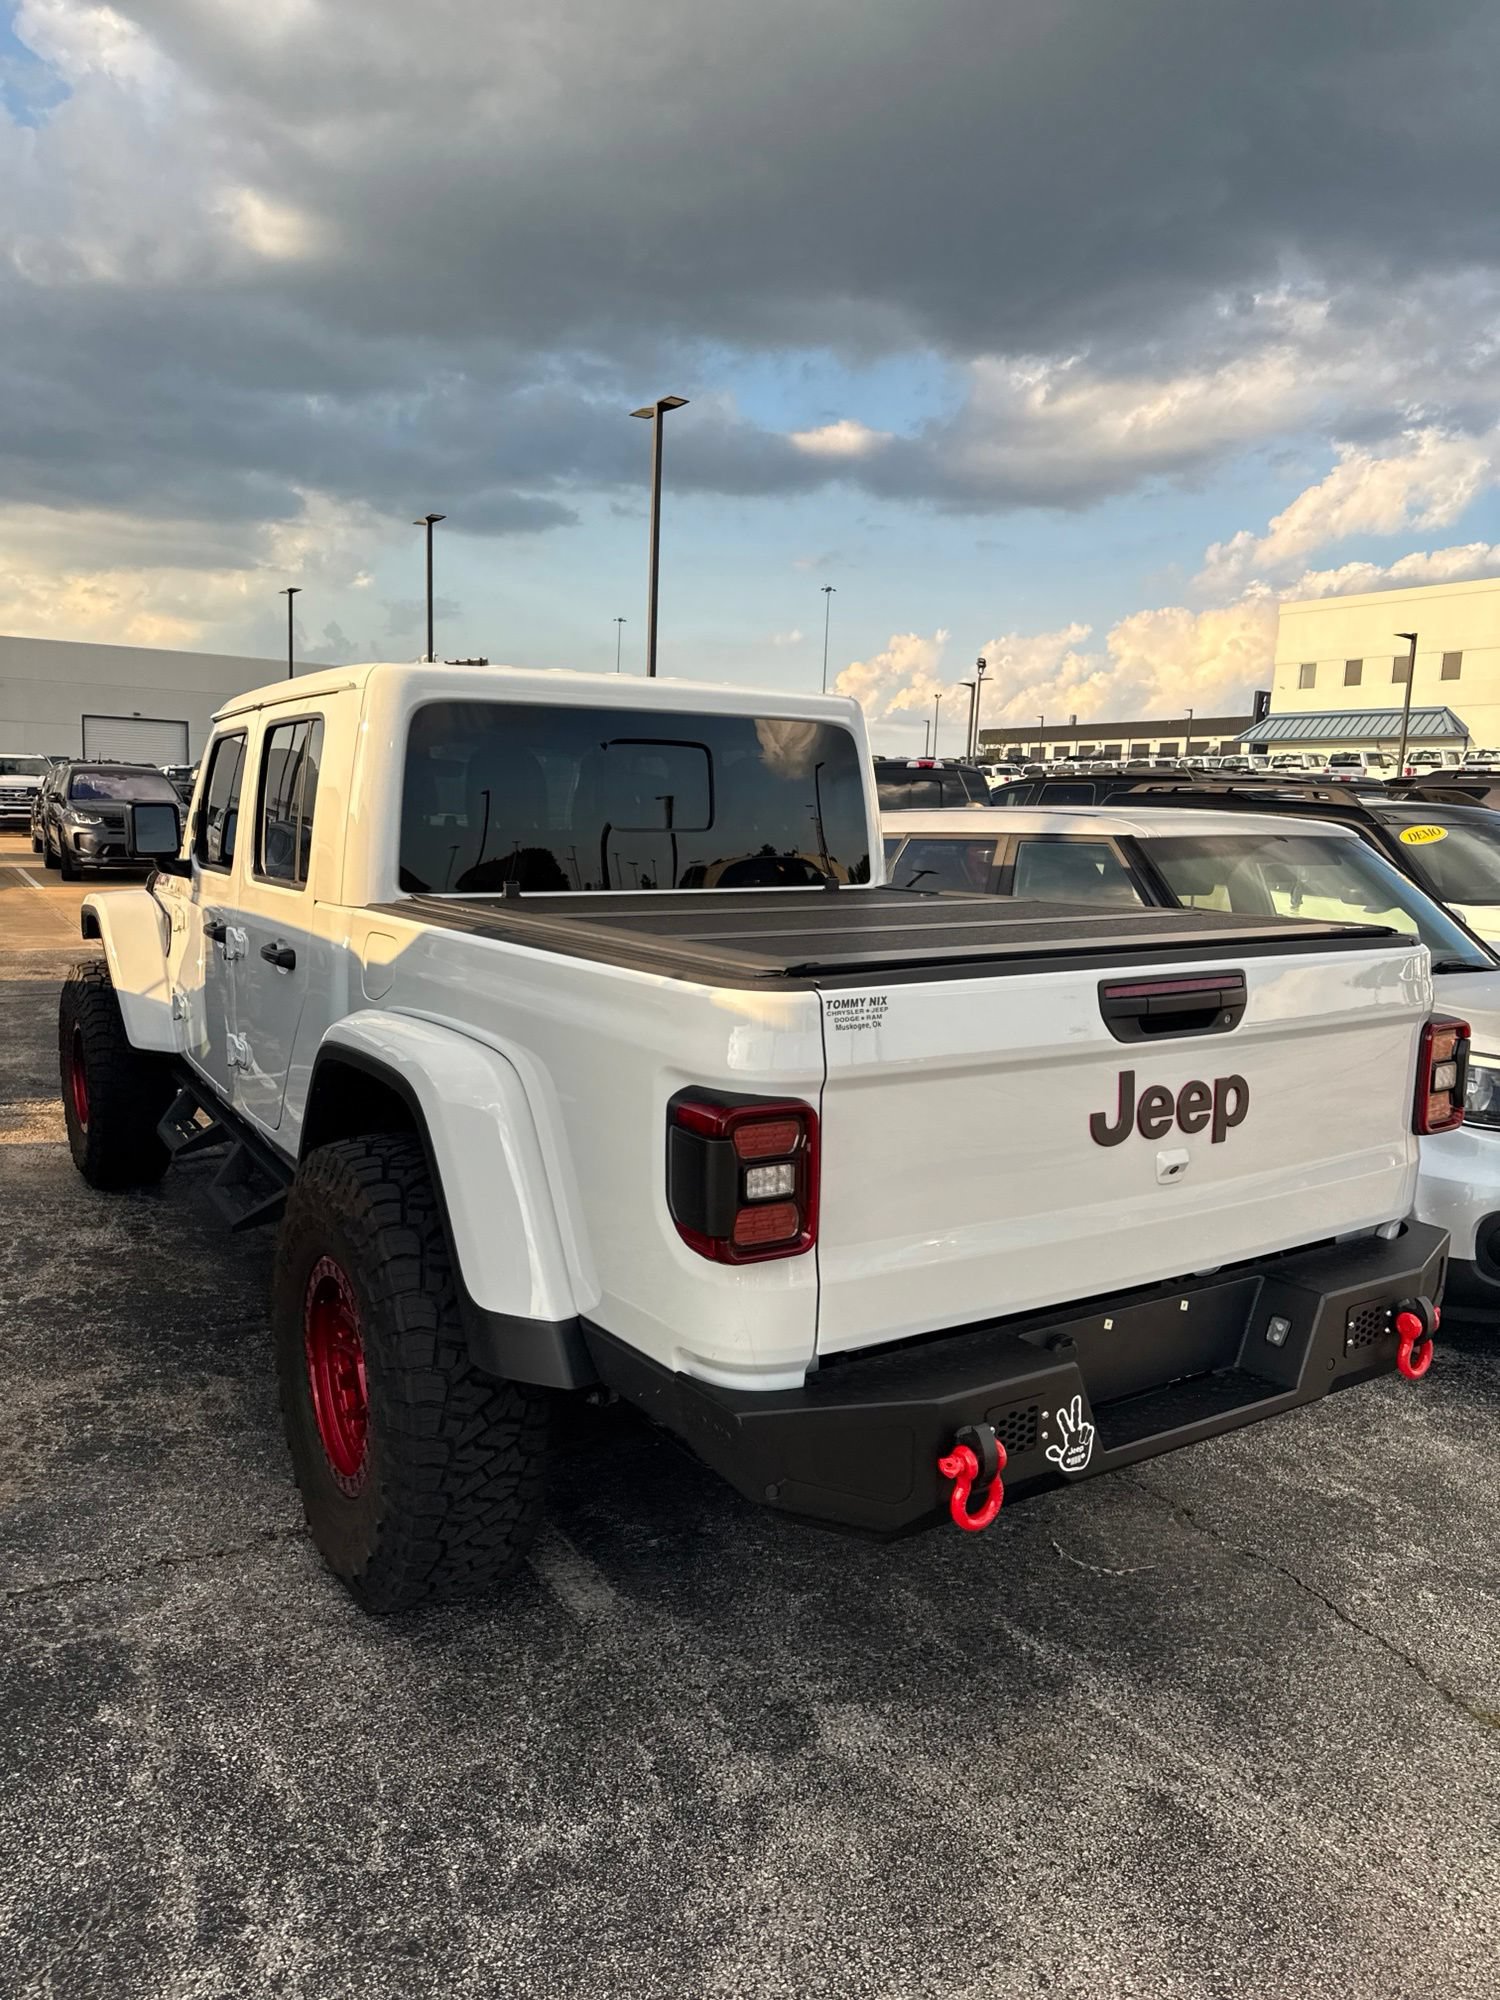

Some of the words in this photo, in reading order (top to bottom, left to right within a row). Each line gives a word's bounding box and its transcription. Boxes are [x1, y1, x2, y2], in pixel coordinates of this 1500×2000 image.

[1408, 828, 1441, 842] DEMO
[826, 998, 866, 1010] TOMMY
[869, 996, 888, 1007] NIX
[826, 1008, 864, 1017] CHRYSLER
[834, 1015, 859, 1023] DODGE
[835, 1022, 871, 1031] Muskogee,
[1090, 1069, 1250, 1147] Jeep
[1068, 1445, 1085, 1455] Jeep
